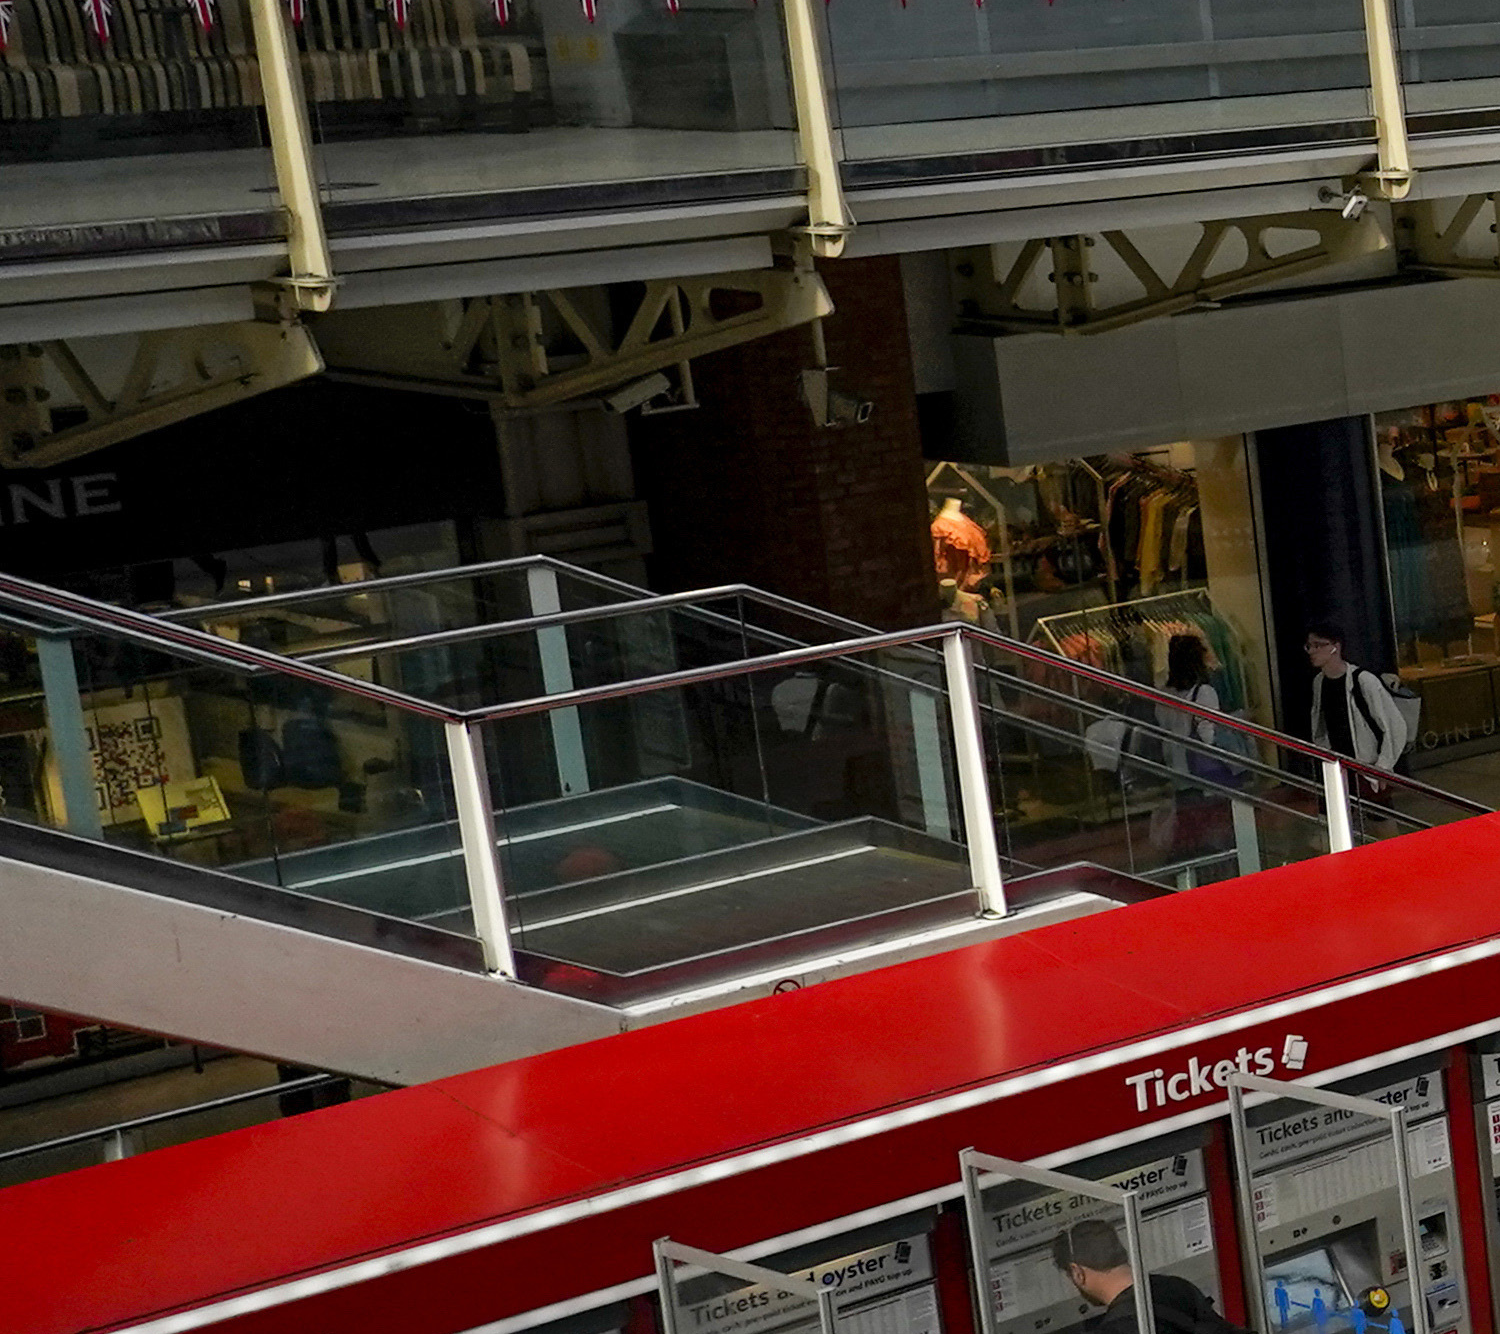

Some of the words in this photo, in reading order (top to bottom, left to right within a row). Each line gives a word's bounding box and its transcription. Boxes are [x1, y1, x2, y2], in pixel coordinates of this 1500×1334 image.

[1125, 1047, 1275, 1112] Tickets
[1256, 1117, 1319, 1145] Tickets
[993, 1199, 1063, 1233] Tickets
[690, 1288, 770, 1326] Tickets
[821, 1252, 888, 1288] oyster
